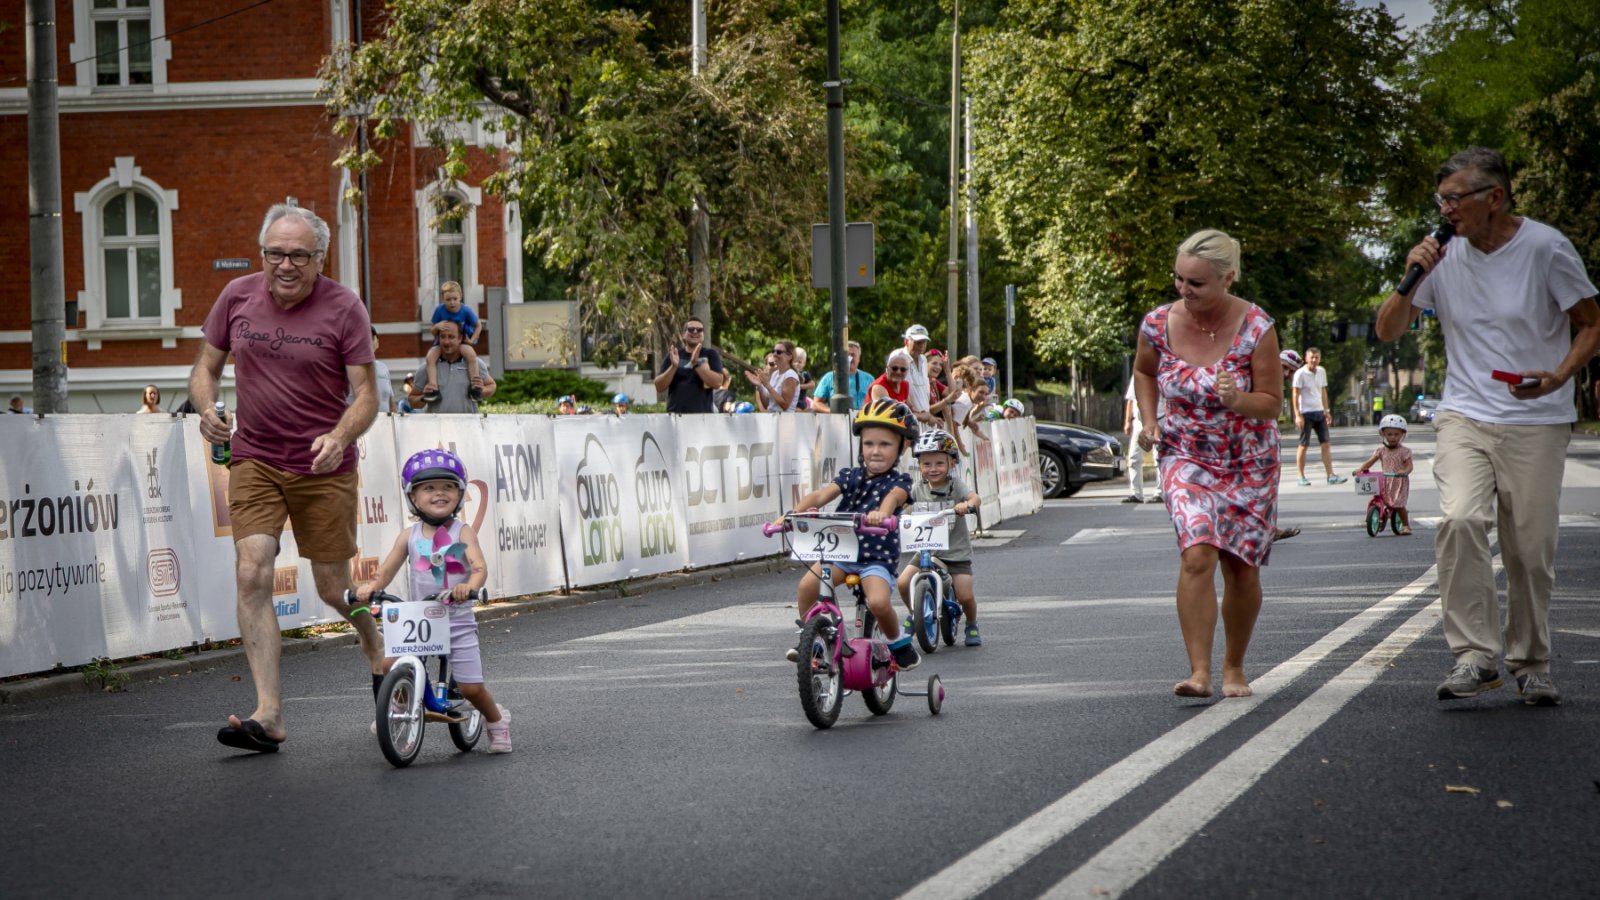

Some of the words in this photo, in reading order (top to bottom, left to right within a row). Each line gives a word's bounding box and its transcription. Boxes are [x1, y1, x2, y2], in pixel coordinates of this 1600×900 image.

[236, 321, 274, 347] Pepe
[270, 327, 323, 350] Jeans
[495, 444, 545, 502] ATOM
[1361, 483, 1372, 492] 43
[576, 472, 620, 520] auto
[635, 469, 672, 513] auto
[364, 495, 388, 524] Ltd.
[499, 519, 547, 555] deweloper
[580, 515, 625, 566] Land
[638, 510, 676, 558] Land
[813, 531, 840, 552] 29
[914, 526, 934, 542] 27
[18, 555, 106, 600] pozytywnie
[272, 568, 298, 593] MET
[403, 619, 432, 643] 20
[391, 644, 444, 654] DZIERŻONIÓW
